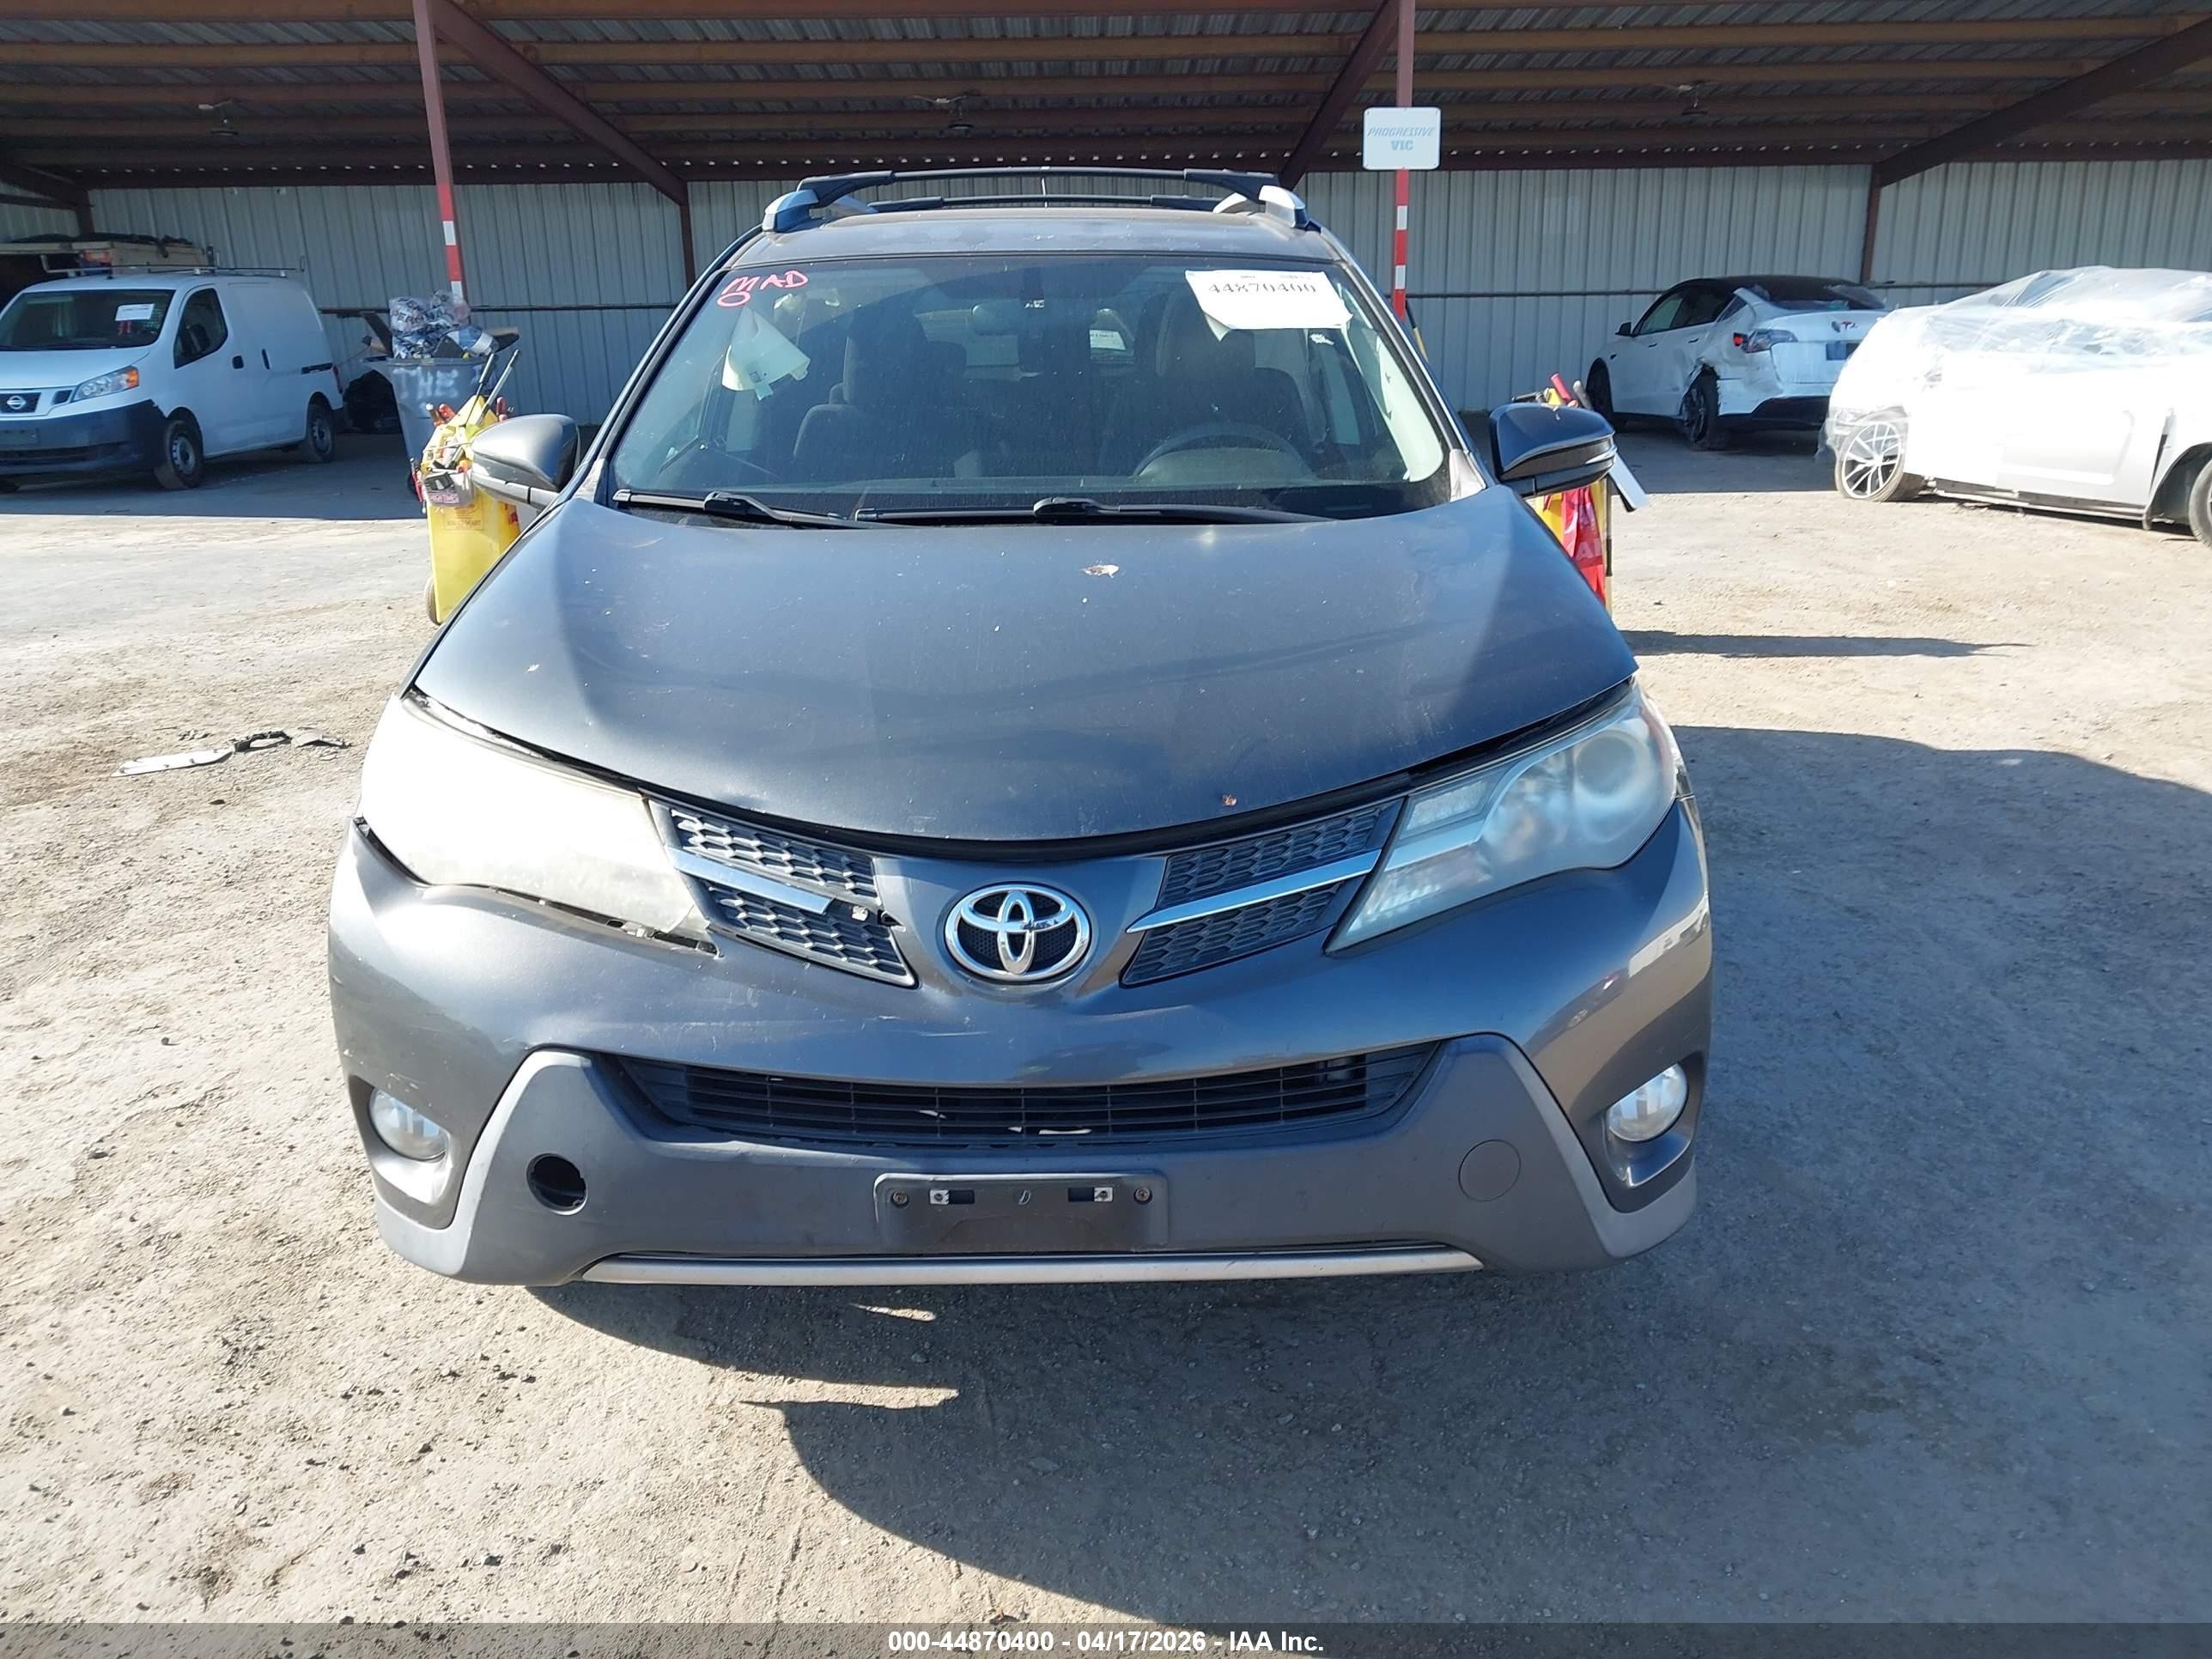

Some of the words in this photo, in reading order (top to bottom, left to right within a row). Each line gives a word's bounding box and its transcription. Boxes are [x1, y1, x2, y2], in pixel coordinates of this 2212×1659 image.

[1367, 126, 1435, 137] PROGRESSIVE
[1389, 139, 1414, 151] VIC
[1207, 282, 1317, 295] 44870400
